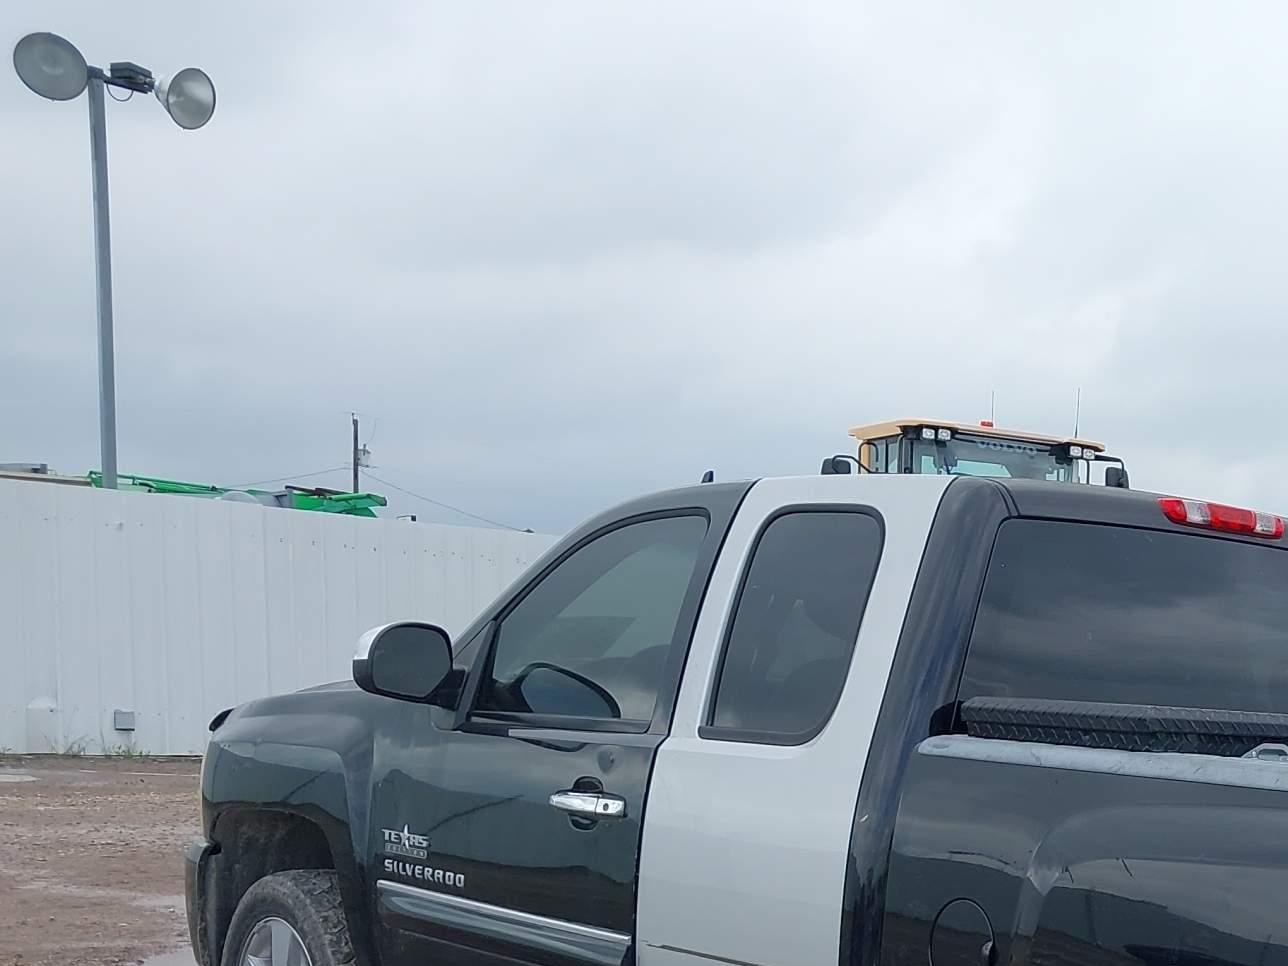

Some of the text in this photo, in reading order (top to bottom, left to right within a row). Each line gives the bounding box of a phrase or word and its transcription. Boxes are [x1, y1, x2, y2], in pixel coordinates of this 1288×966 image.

[978, 441, 1037, 455] VOLVO
[381, 825, 431, 850] TEXAS
[384, 859, 465, 888] SILVERADO
